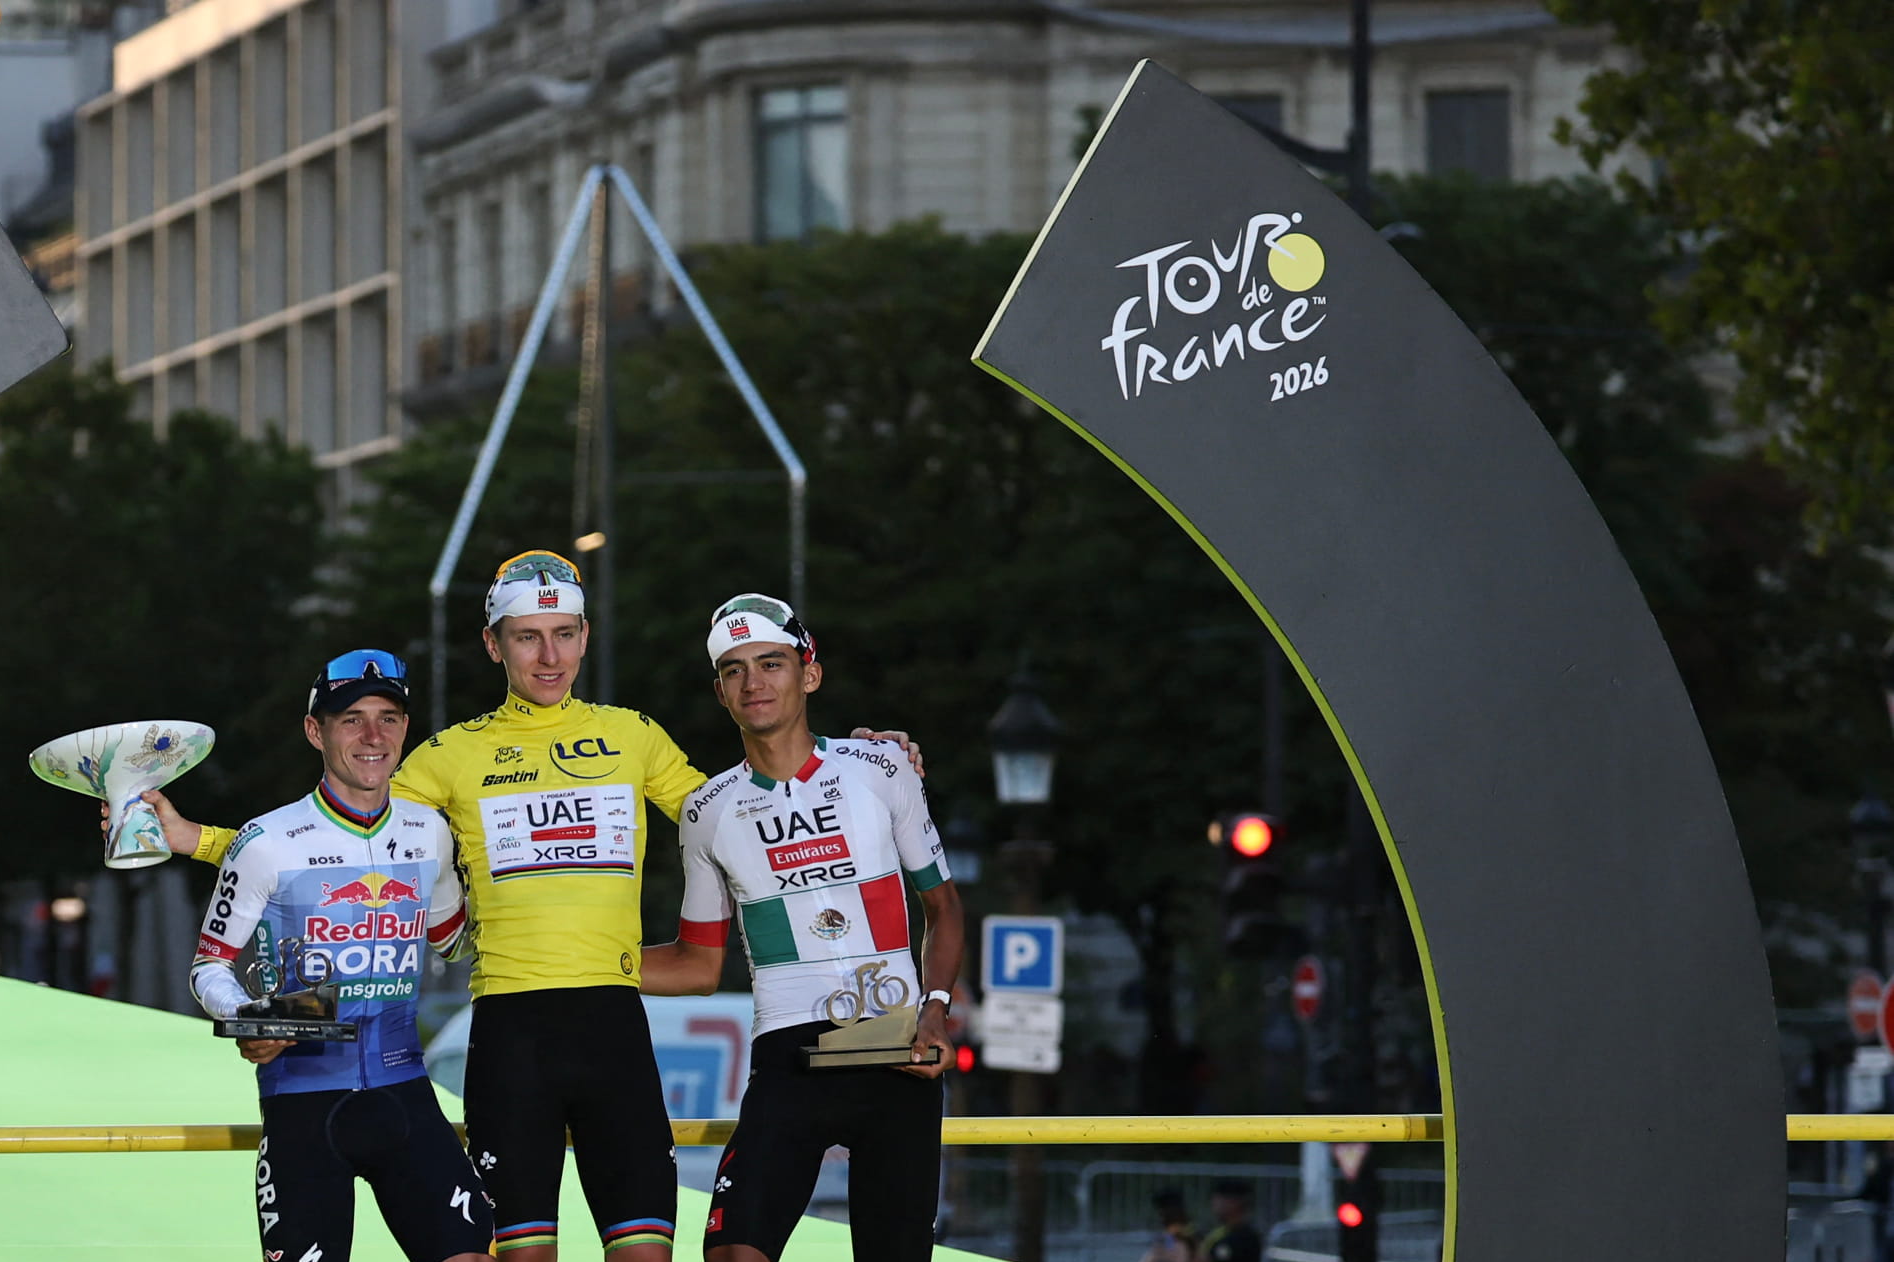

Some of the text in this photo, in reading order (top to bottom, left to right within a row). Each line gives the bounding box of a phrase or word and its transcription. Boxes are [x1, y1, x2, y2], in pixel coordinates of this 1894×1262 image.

[1114, 212, 1302, 328] TOUR
[1242, 276, 1273, 310] de
[1270, 356, 1328, 401] 2026
[538, 589, 559, 597] UAE
[726, 617, 747, 629] UAE
[515, 703, 534, 716] LCL
[555, 738, 621, 760] LCL
[848, 748, 898, 778] Analog
[482, 769, 539, 786] Santini
[694, 775, 738, 812] Analog
[526, 798, 594, 827] UAE
[756, 804, 841, 844] UAE
[308, 855, 344, 866] BOSS
[533, 845, 597, 862] XRG
[774, 843, 841, 864] Emirates
[774, 862, 856, 890] XRG
[208, 869, 239, 936] BOSS
[305, 944, 418, 976] BORA
[1003, 931, 1041, 982] P
[257, 1136, 280, 1237] BORA
